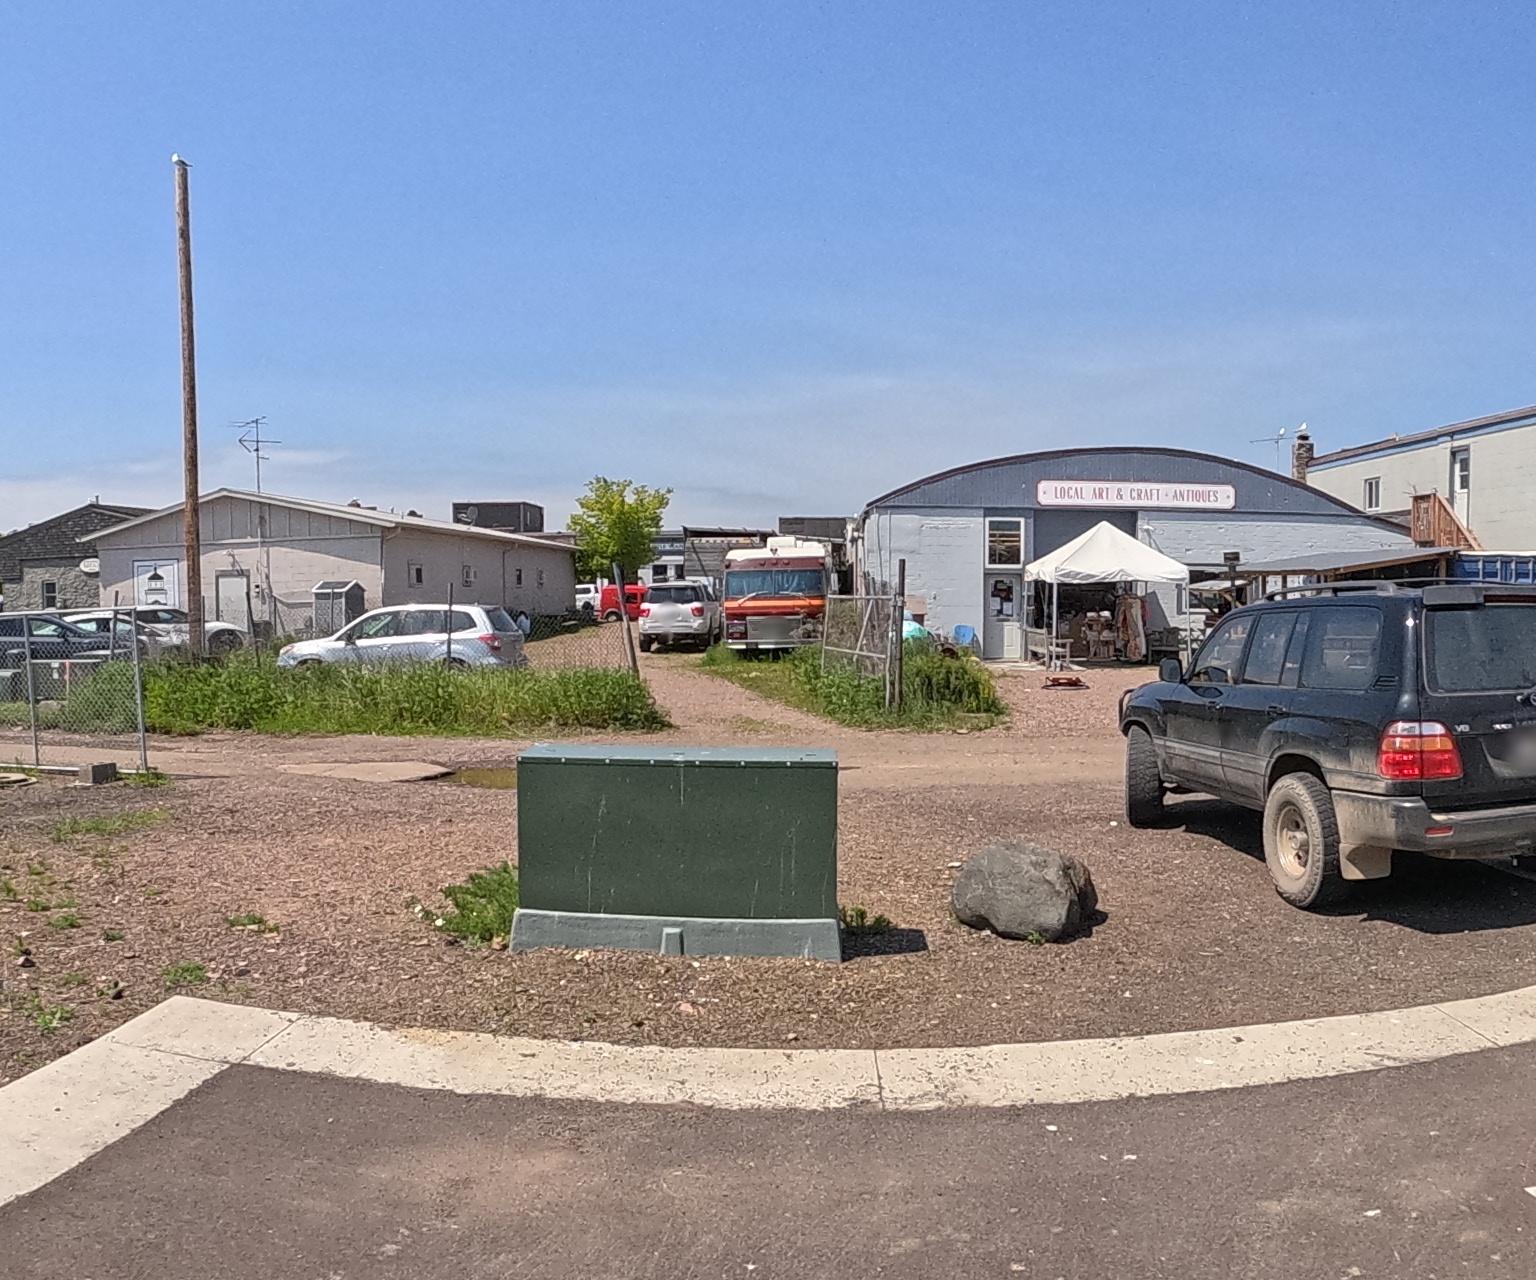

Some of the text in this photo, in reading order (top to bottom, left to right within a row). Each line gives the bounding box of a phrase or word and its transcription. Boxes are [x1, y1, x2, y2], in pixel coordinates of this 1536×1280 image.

[1054, 486, 1219, 503] LOCAL ART & CRAFT ANTIQUES
